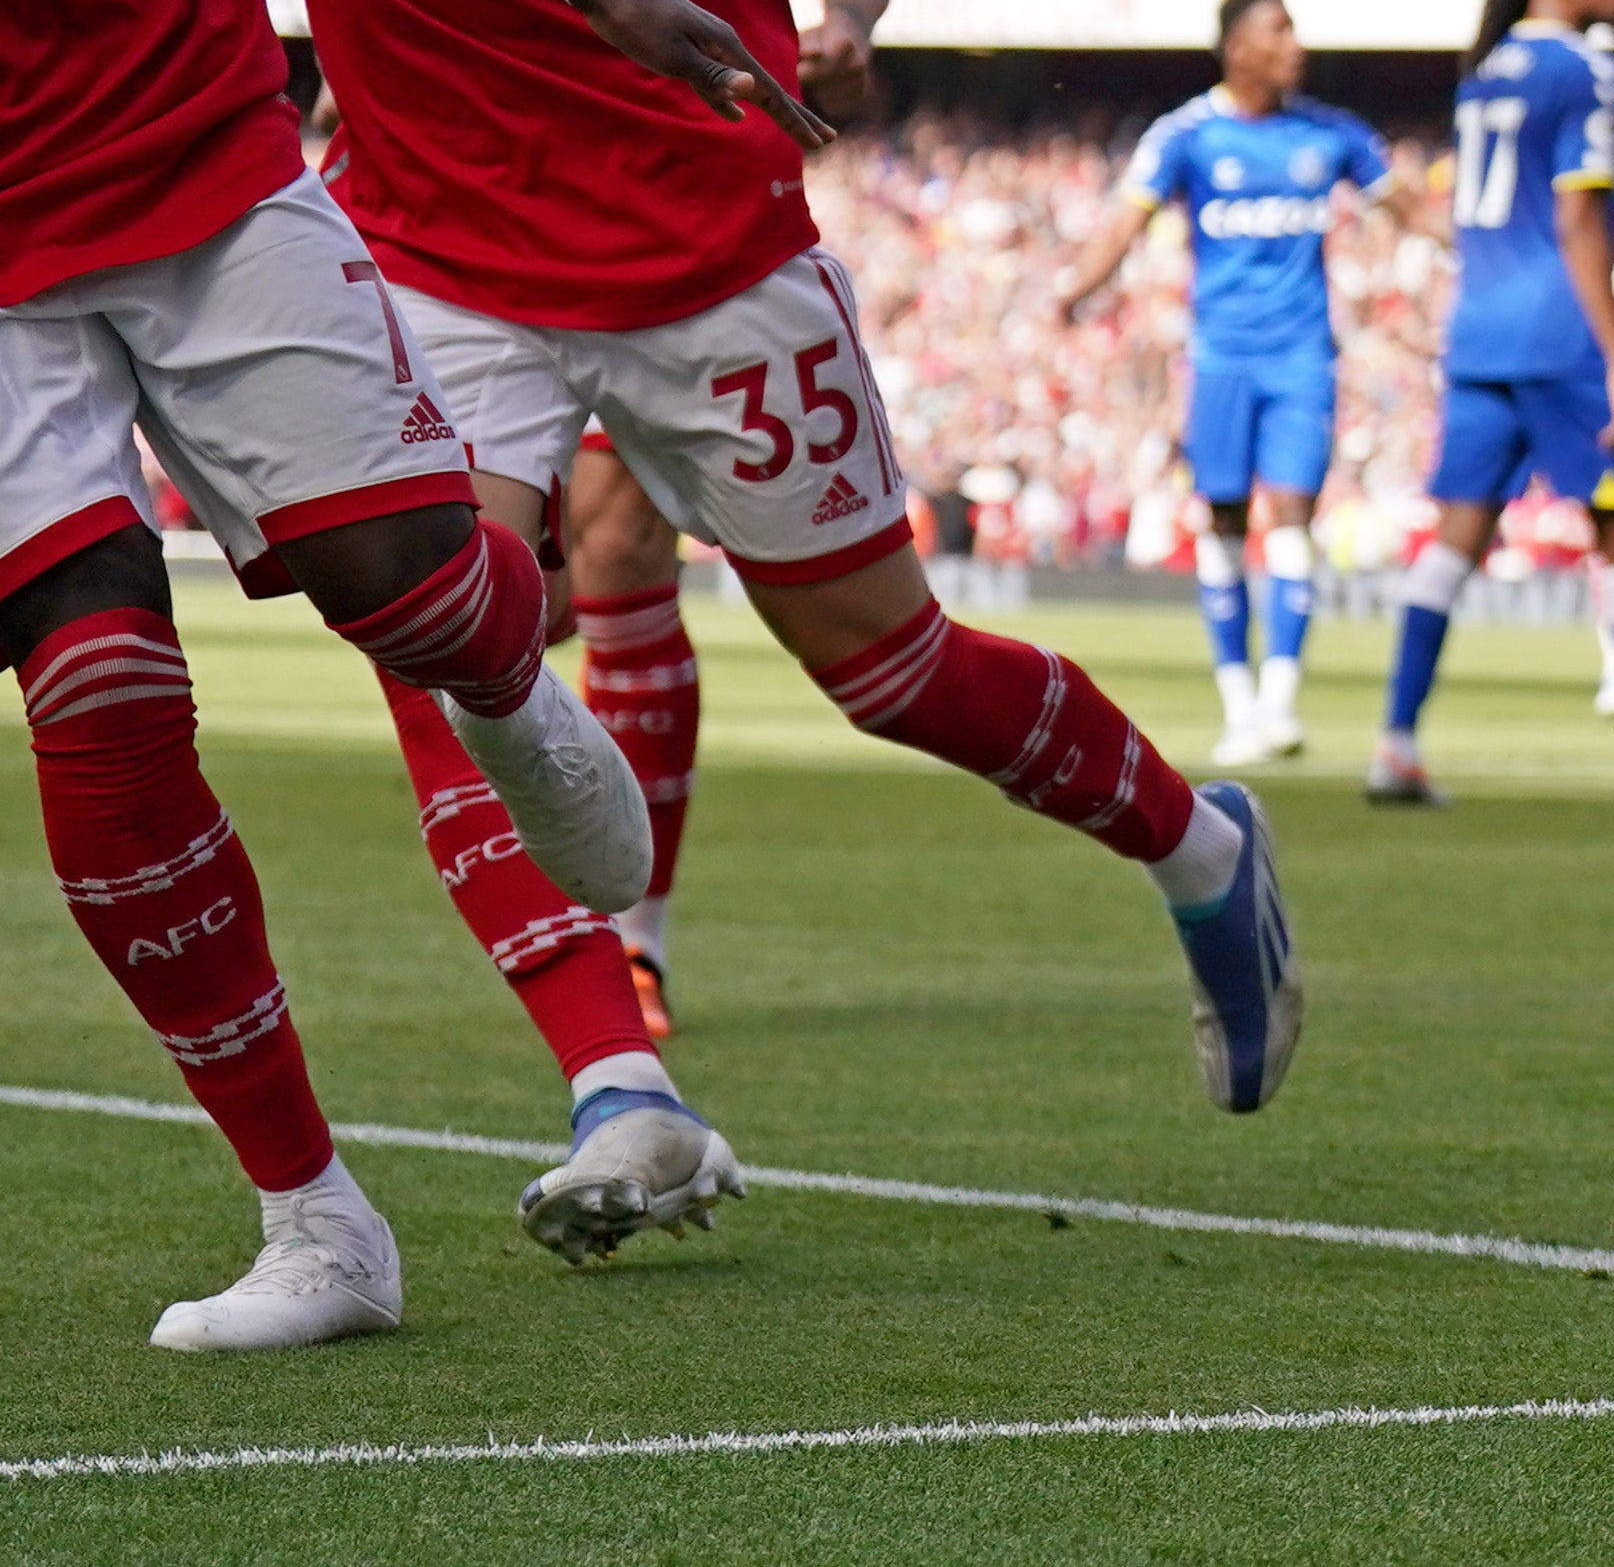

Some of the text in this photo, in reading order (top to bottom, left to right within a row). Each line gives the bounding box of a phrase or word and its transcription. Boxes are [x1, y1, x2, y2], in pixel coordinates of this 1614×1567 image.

[1454, 96, 1529, 228] 17
[341, 260, 413, 384] 7
[711, 336, 859, 482] 35
[811, 495, 868, 526] adidas
[441, 831, 522, 895] AFC
[128, 896, 237, 966] AFC
